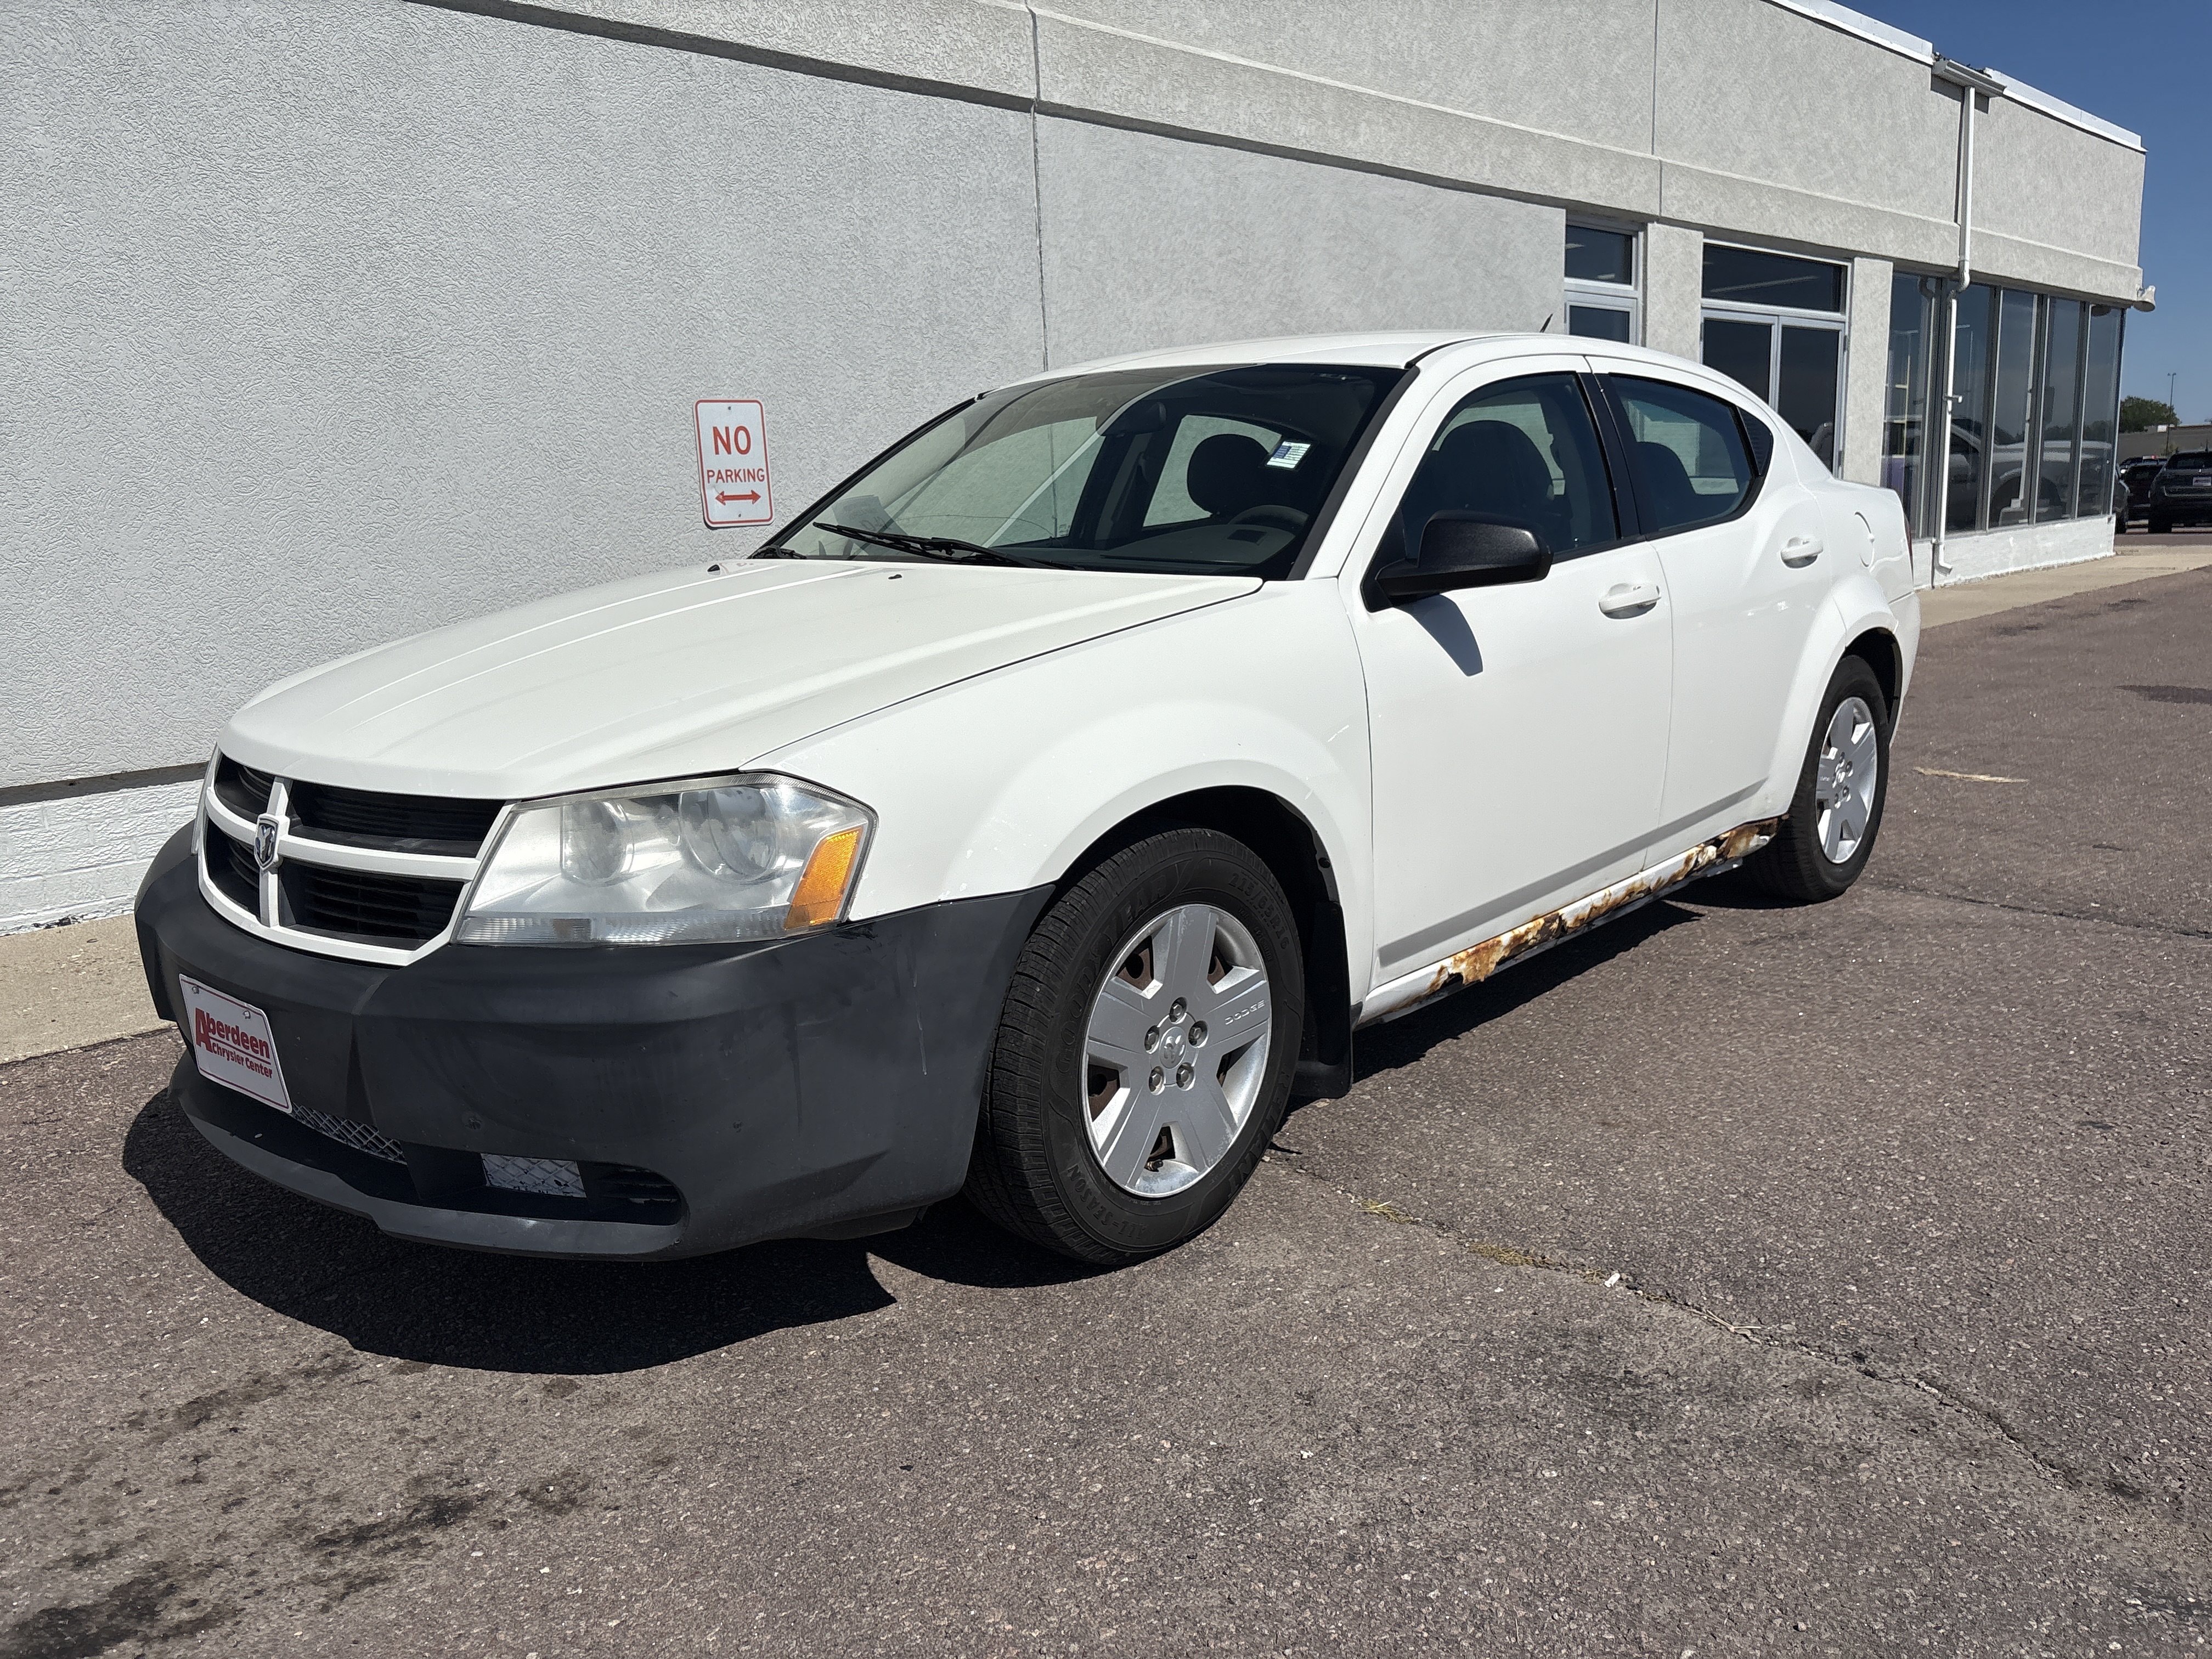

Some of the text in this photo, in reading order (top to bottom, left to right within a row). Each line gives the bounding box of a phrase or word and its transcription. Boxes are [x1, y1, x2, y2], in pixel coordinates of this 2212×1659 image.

[713, 426, 751, 455] NO
[707, 469, 765, 483] PARKING
[1056, 871, 1169, 1074] GOODYEAR
[195, 1007, 270, 1059] Aberdeen
[1224, 1000, 1265, 1025] DODGE
[212, 1042, 273, 1079] Chrysler Center
[1227, 1069, 1290, 1198] RELIANT
[1066, 1164, 1148, 1238] ALL-SEASON
